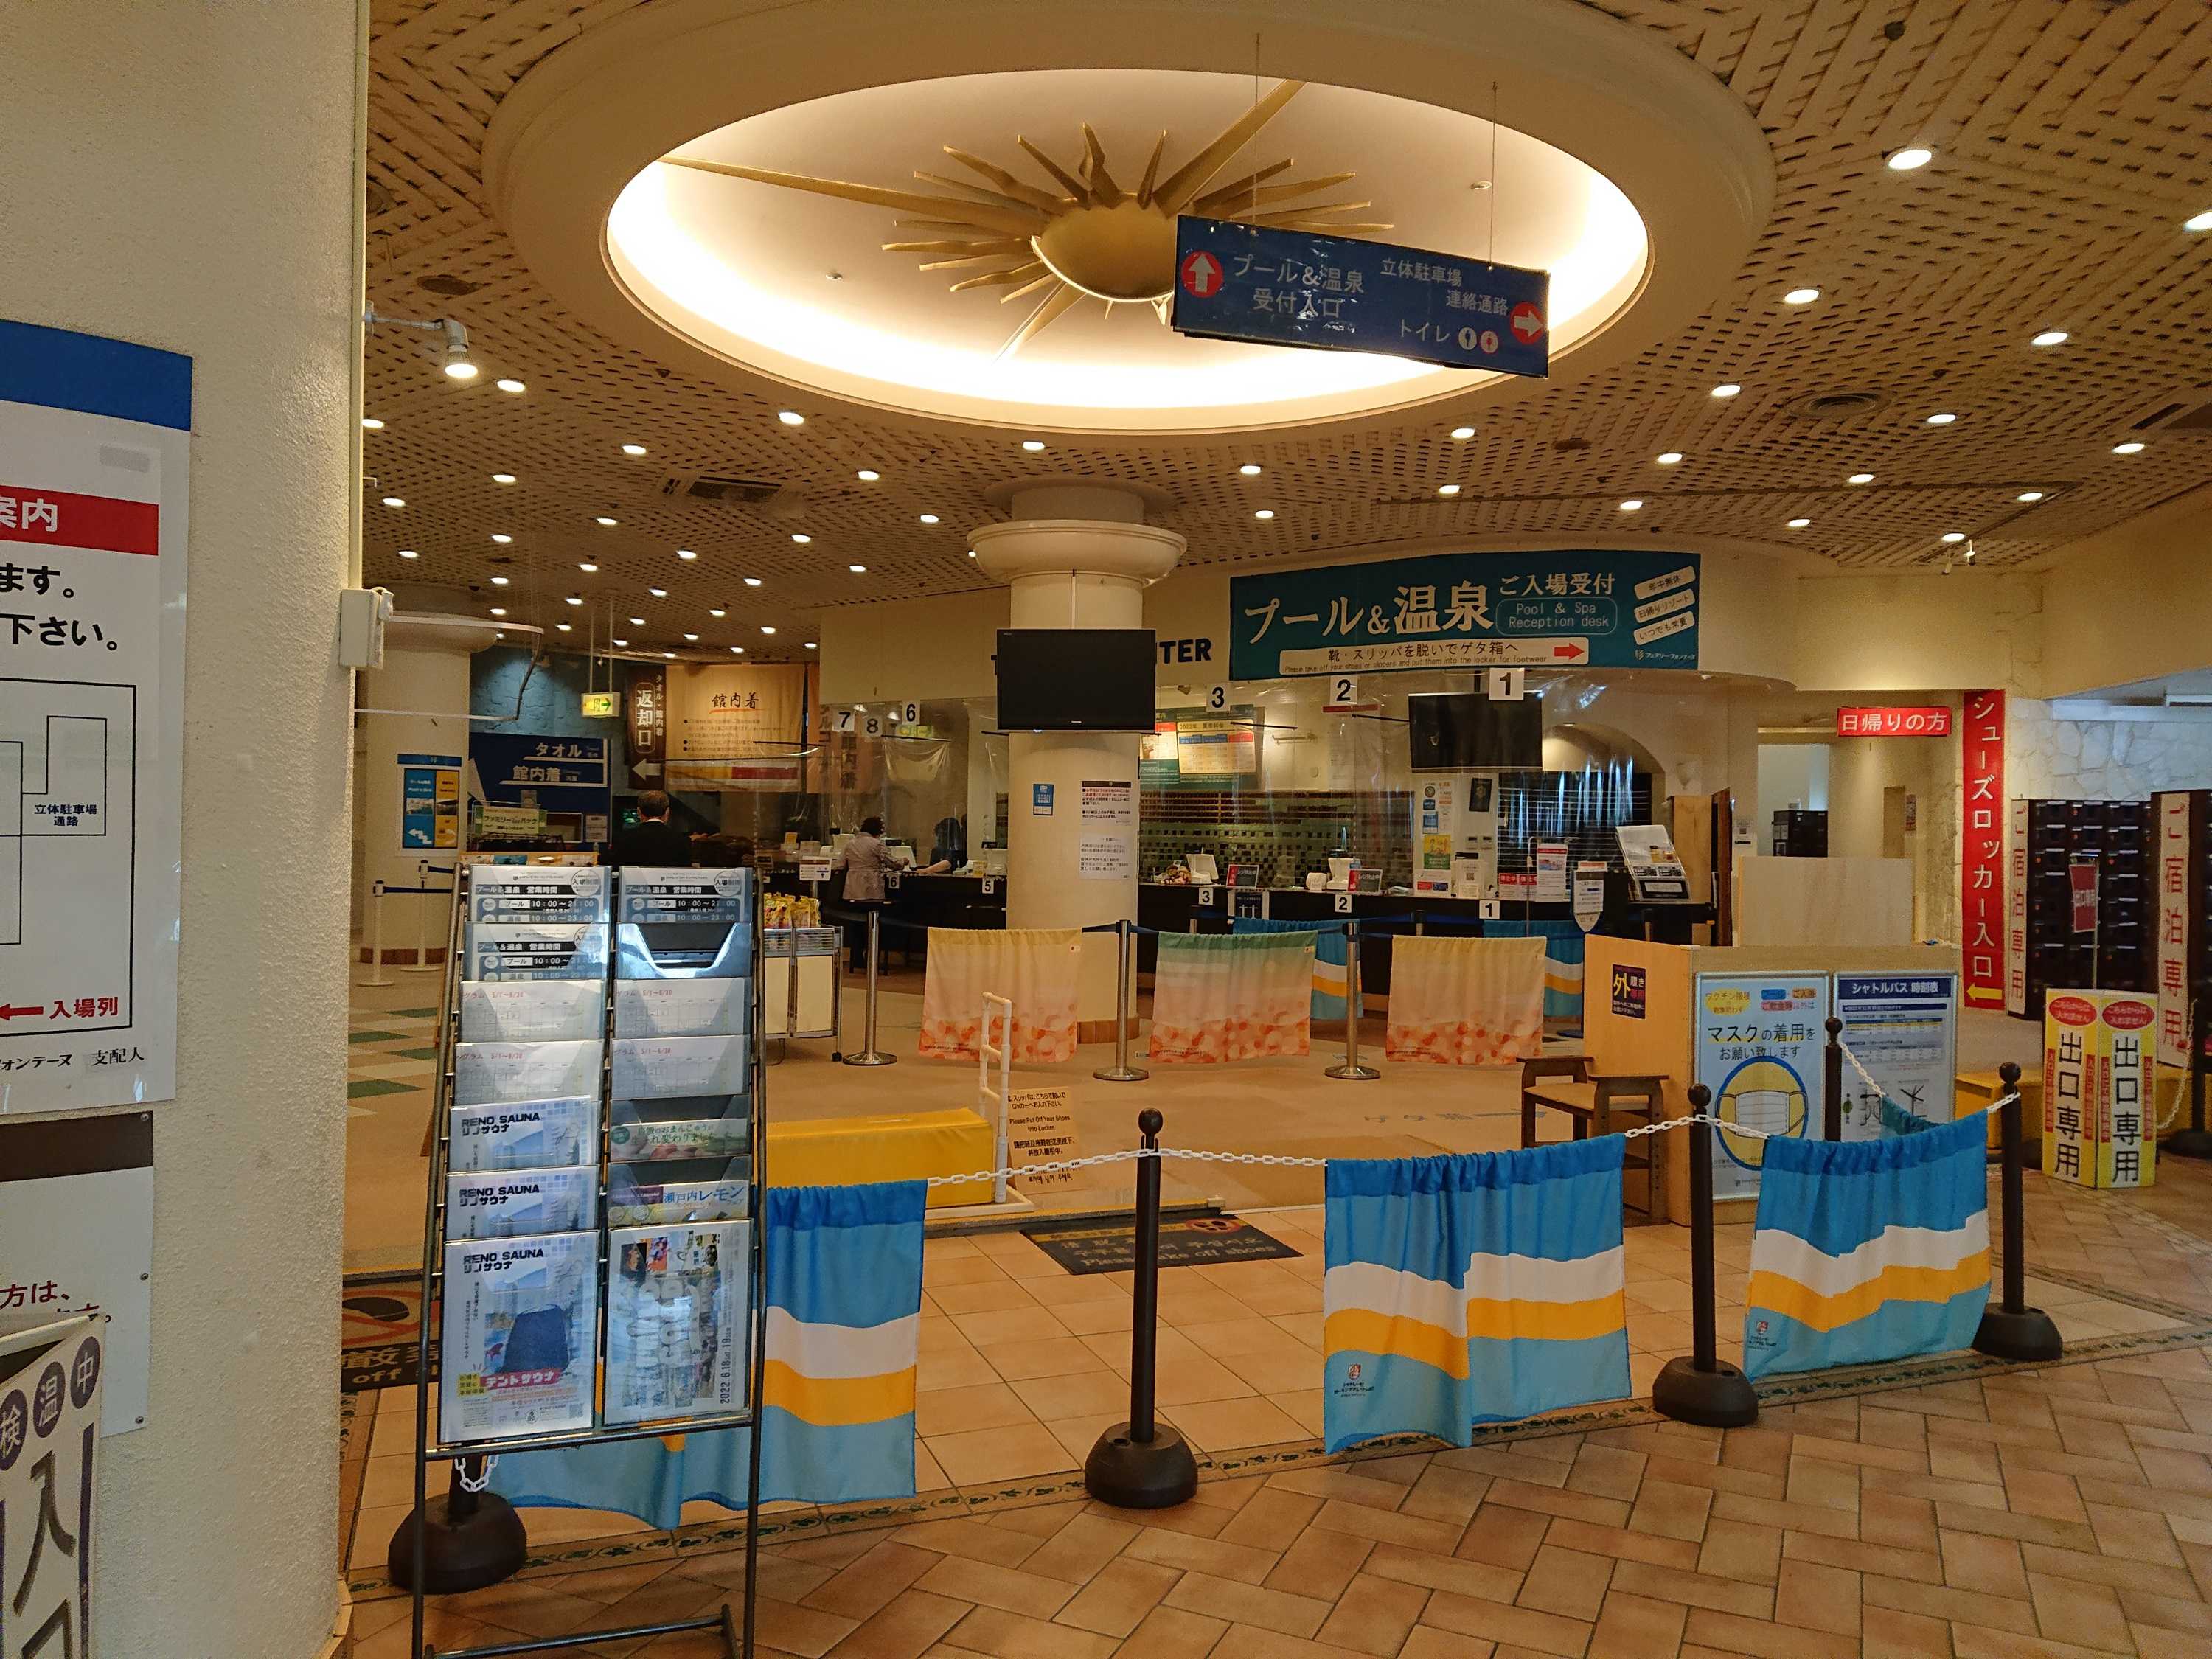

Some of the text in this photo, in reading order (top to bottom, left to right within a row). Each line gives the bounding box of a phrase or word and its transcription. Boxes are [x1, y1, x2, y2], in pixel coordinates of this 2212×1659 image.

[1233, 254, 1365, 294] プール&温泉
[1381, 257, 1462, 287] 立体駐車場
[1252, 288, 1344, 319] 受付入口
[1400, 319, 1450, 343] トイレ
[1498, 572, 1616, 597] ご入場受付
[1245, 579, 1495, 644] プール&温泉
[1516, 601, 1597, 616] Pool & Spa
[1638, 594, 1690, 619] 日帰りリゾート
[1509, 613, 1610, 630] Reception desk
[0, 613, 118, 651] 下さい。
[1513, 655, 1547, 663] footwear
[1335, 678, 1352, 702] 2
[1498, 671, 1512, 697] 1
[711, 691, 760, 709] 館内着
[1211, 686, 1225, 709] 3
[636, 689, 653, 747] 返却口
[838, 712, 852, 728] 7
[905, 703, 916, 722] 6
[1842, 711, 1948, 733] 日帰りの方
[866, 718, 879, 734] 8
[535, 742, 582, 758] タオル
[512, 765, 561, 782] 館内着
[35, 803, 97, 816] 立体駐車場
[53, 815, 79, 827] 通路
[1972, 695, 2002, 979] シューズロッカー入口
[889, 876, 897, 888] 6
[984, 880, 991, 893] 5
[1202, 889, 1211, 904] 3
[1338, 897, 1348, 911] 2
[1485, 902, 1494, 917] 1
[1851, 981, 1908, 995] シャトルバス
[49, 996, 119, 1020] 入場列
[1708, 1023, 1816, 1043] マスクの着用を
[0, 1046, 145, 1071] ォンテーヌ 支配人
[1719, 1045, 1801, 1061] お願い致します
[2054, 1032, 2082, 1178] 出口専用
[2112, 1035, 2142, 1183] 出口専用
[461, 1112, 541, 1128] RENO SAUNA
[459, 1184, 540, 1200] RENO SAUNA
[463, 1248, 544, 1265] RENO SAUNA
[1080, 1256, 1134, 1267] Pleas
[1194, 1248, 1221, 1257] off
[1225, 1245, 1278, 1256] shoes
[0, 1279, 71, 1310] 方は、
[352, 1368, 402, 1384] off
[485, 1370, 556, 1388] テントサウナ
[0, 1350, 94, 1460] 検温中
